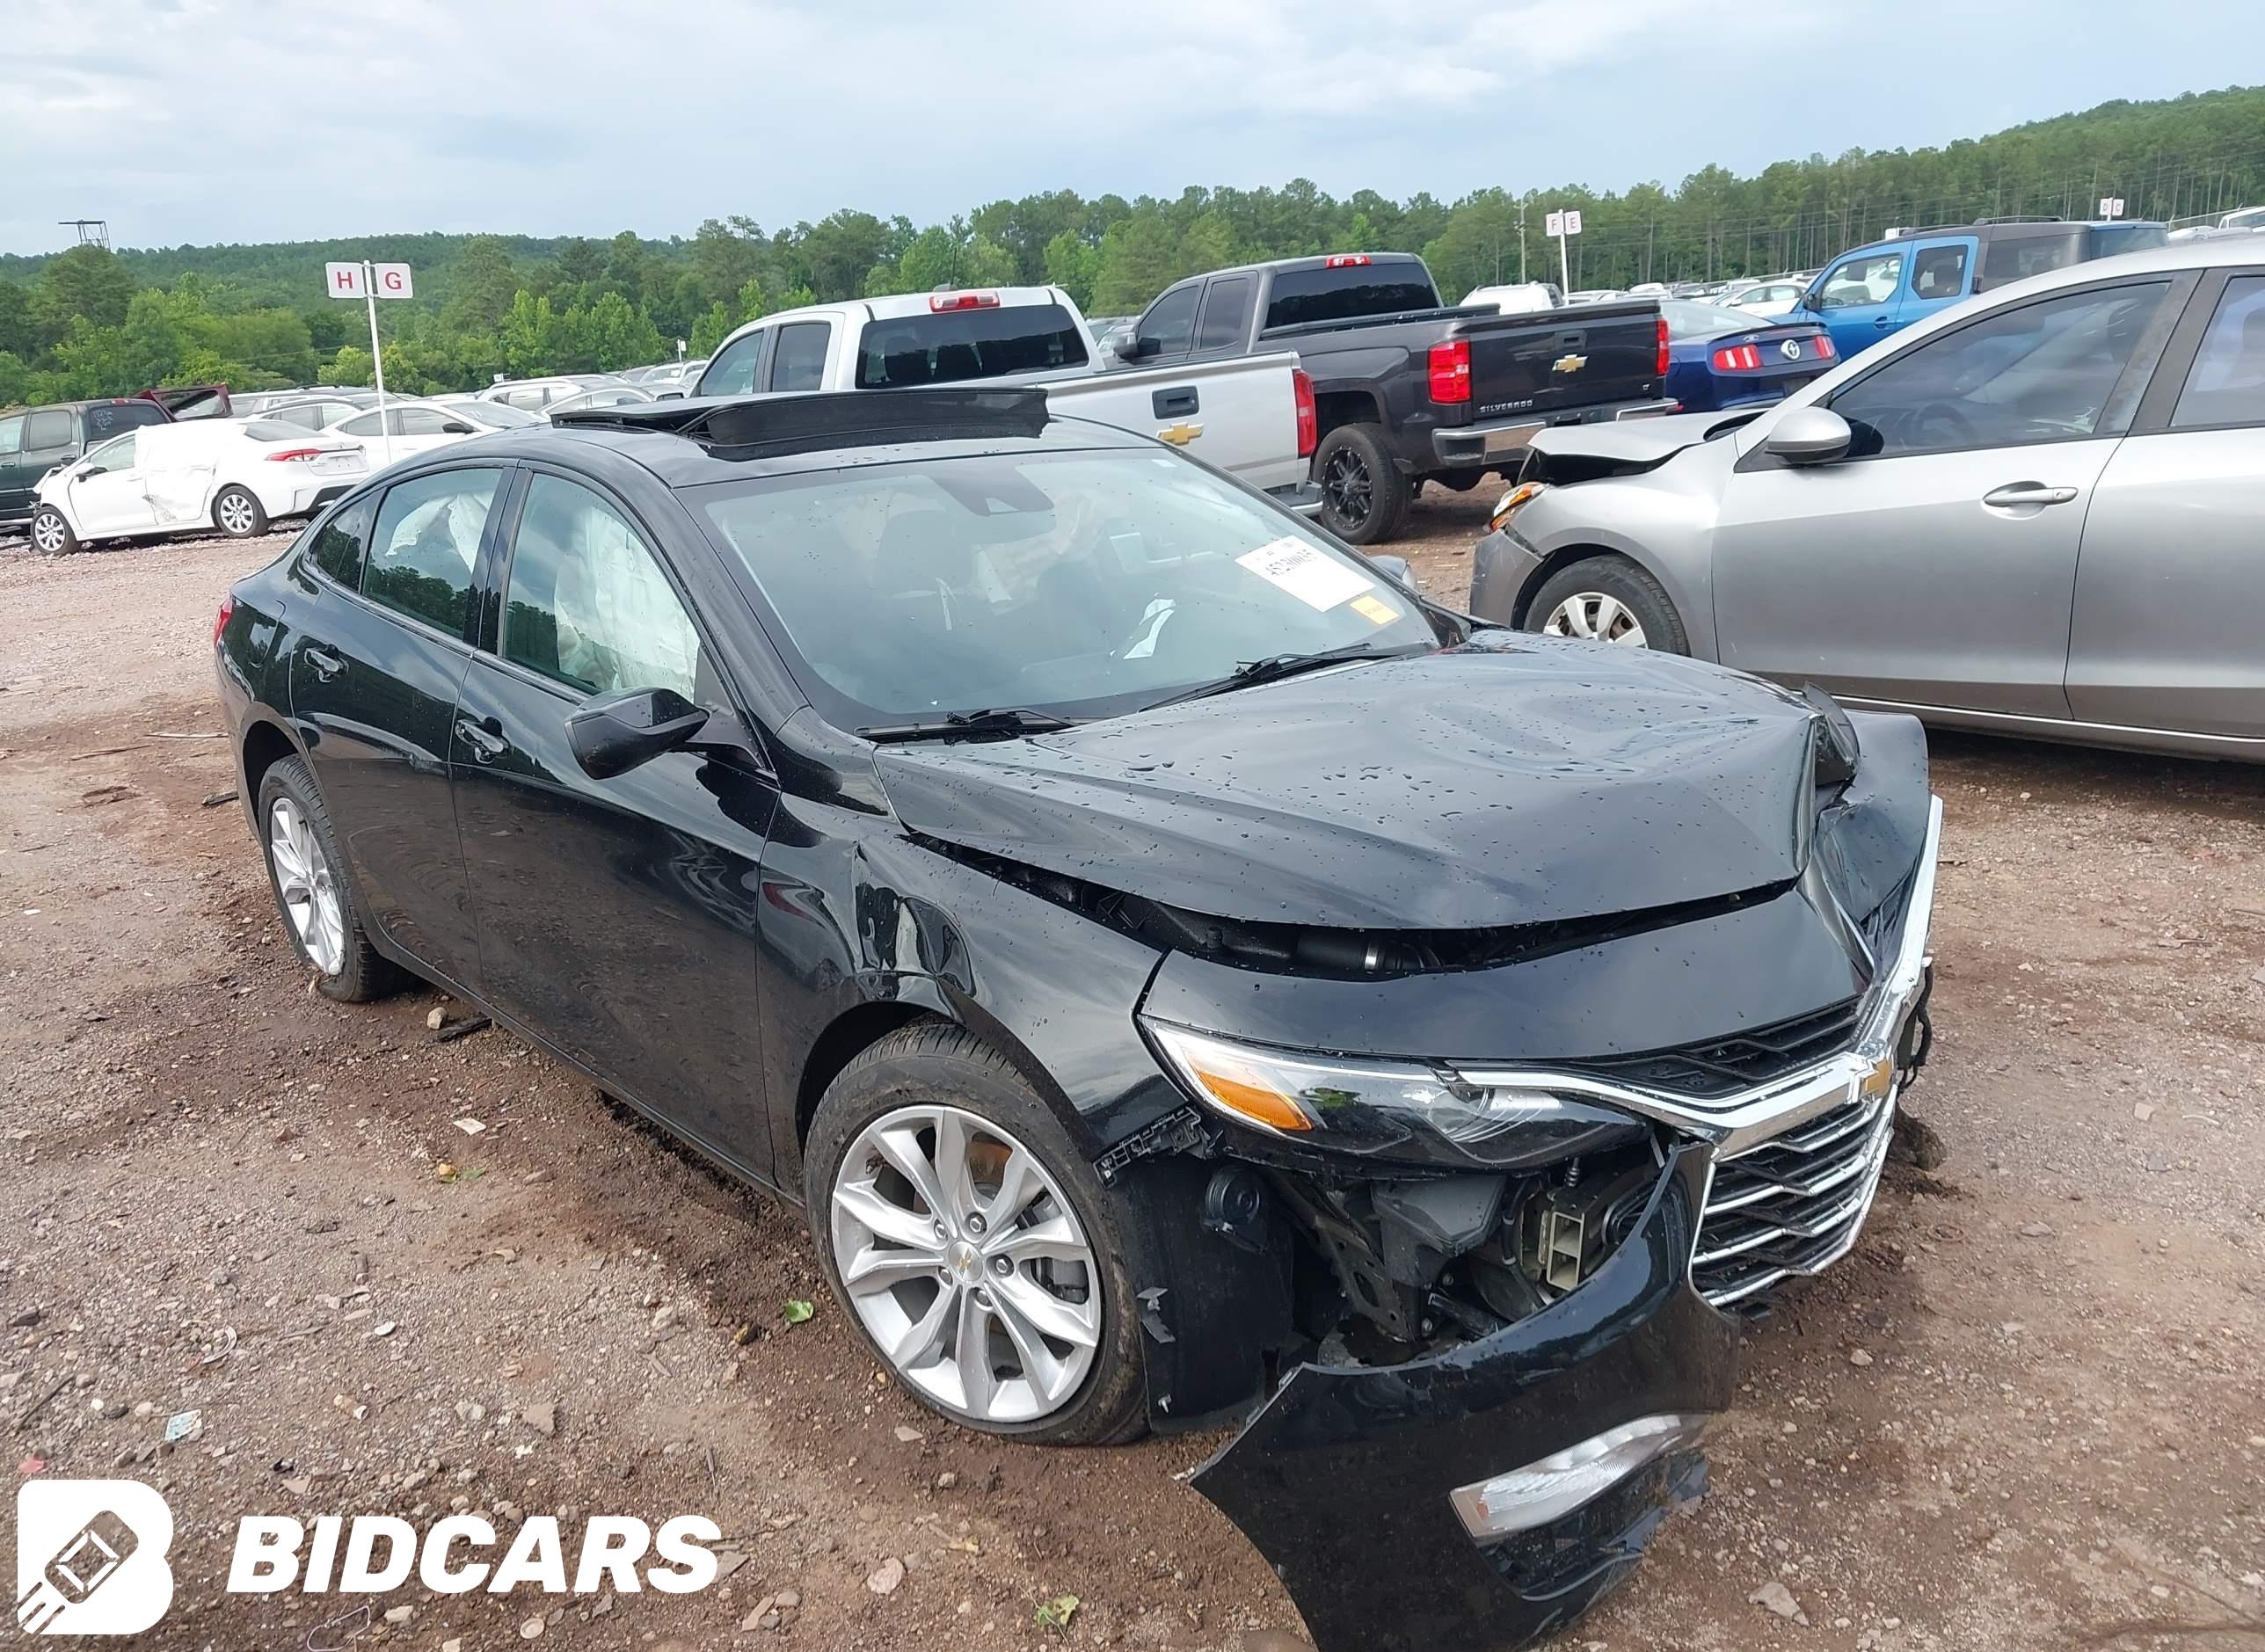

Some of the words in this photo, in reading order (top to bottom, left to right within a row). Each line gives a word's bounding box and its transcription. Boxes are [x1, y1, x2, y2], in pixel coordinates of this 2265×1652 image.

[1551, 218, 1557, 230] F
[1569, 216, 1577, 229] E
[337, 271, 353, 289] H
[384, 271, 402, 290] G
[1479, 399, 1533, 413] SILVERADO
